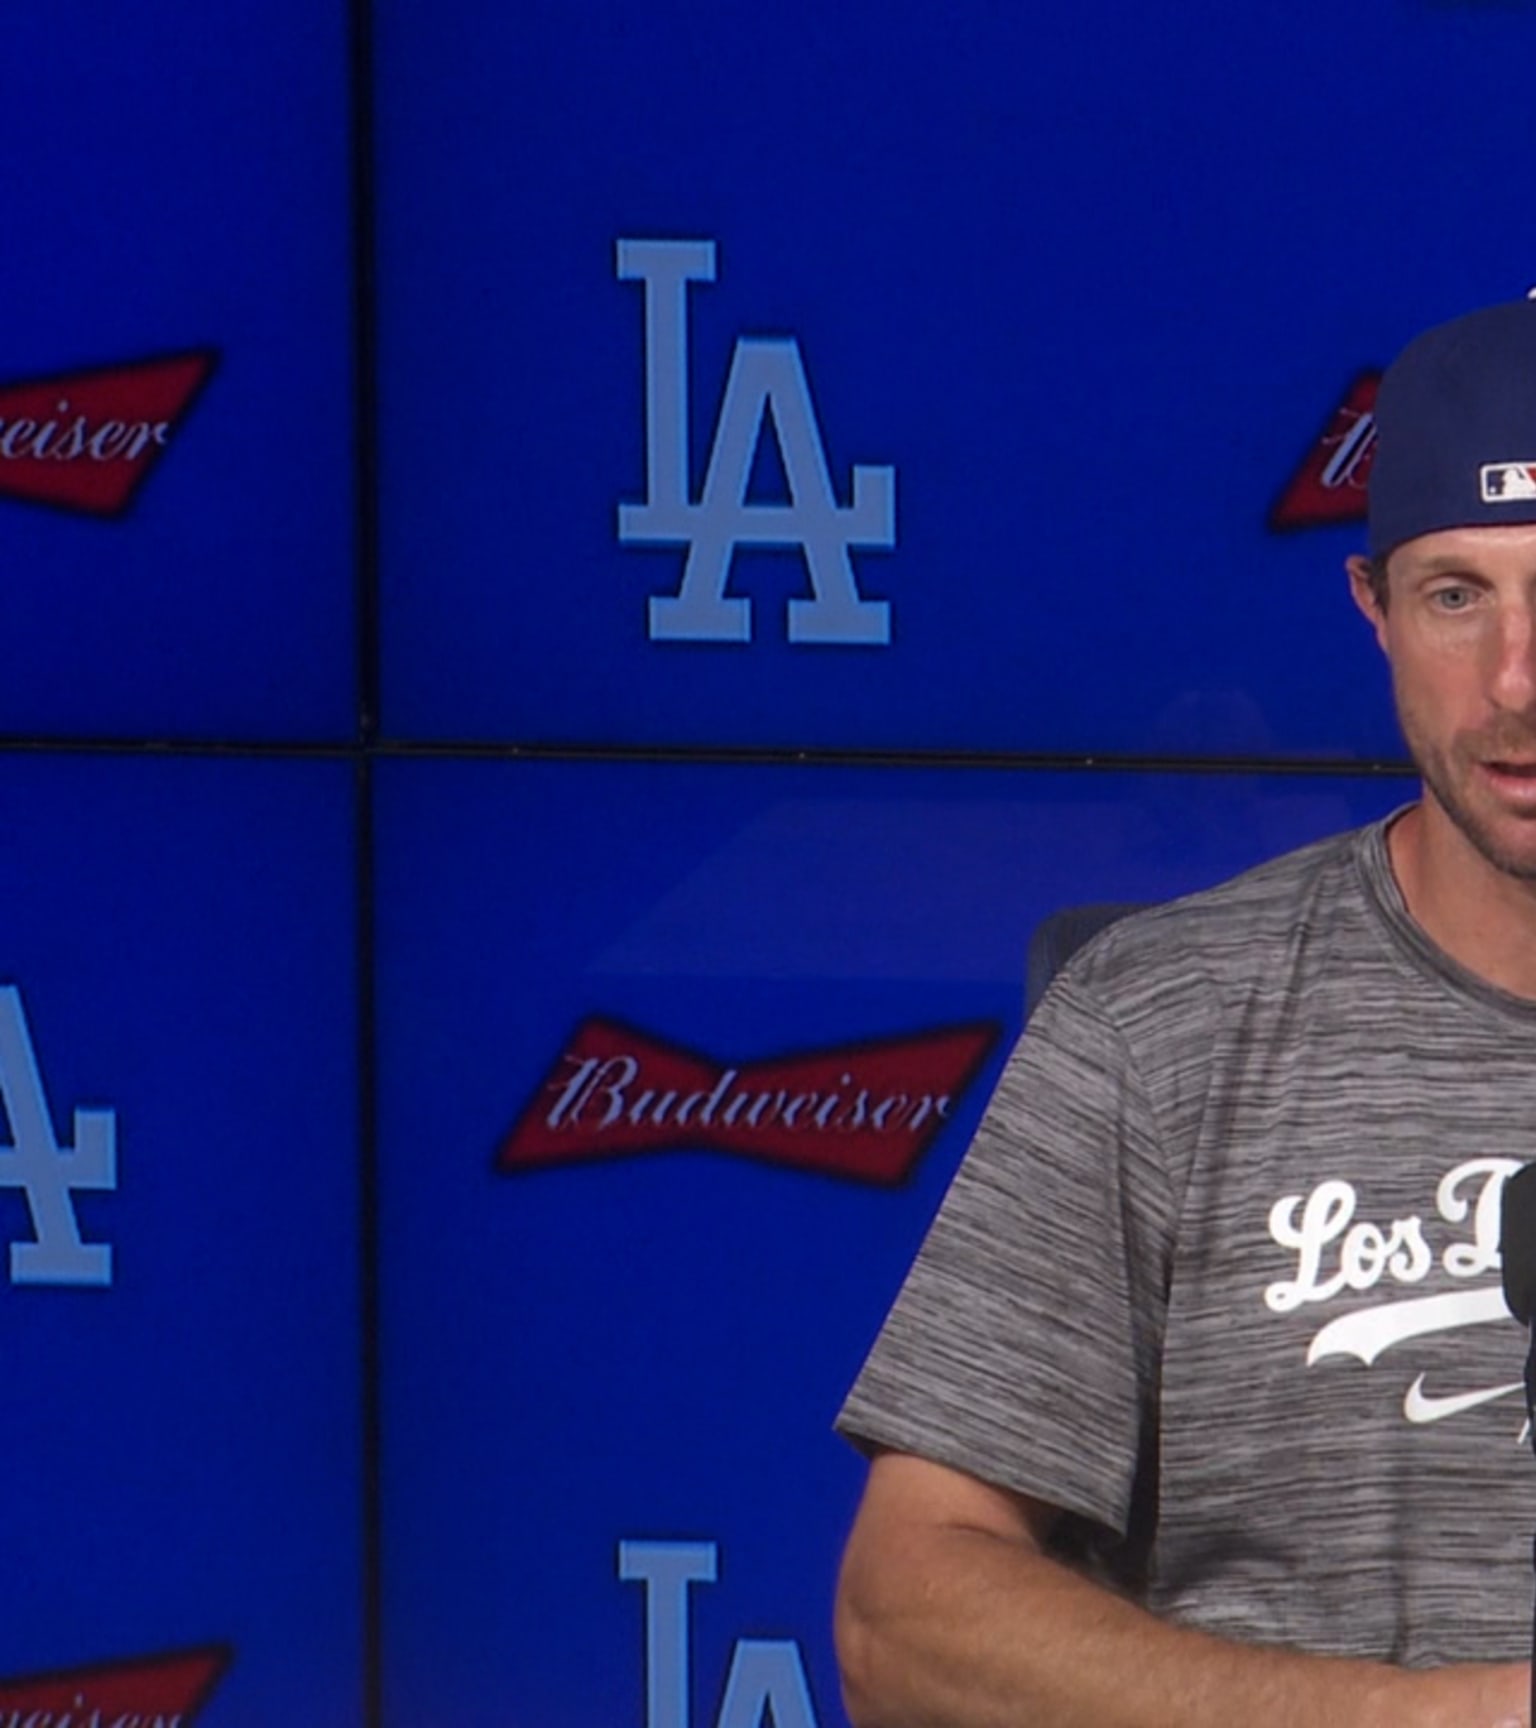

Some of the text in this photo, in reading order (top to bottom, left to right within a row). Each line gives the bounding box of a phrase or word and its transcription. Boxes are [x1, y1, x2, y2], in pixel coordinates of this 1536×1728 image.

[0, 399, 169, 460] eiser
[617, 240, 894, 643] LA
[546, 1054, 951, 1131] Budweiser
[1264, 1180, 1431, 1312] Los
[618, 1540, 818, 1728] L
